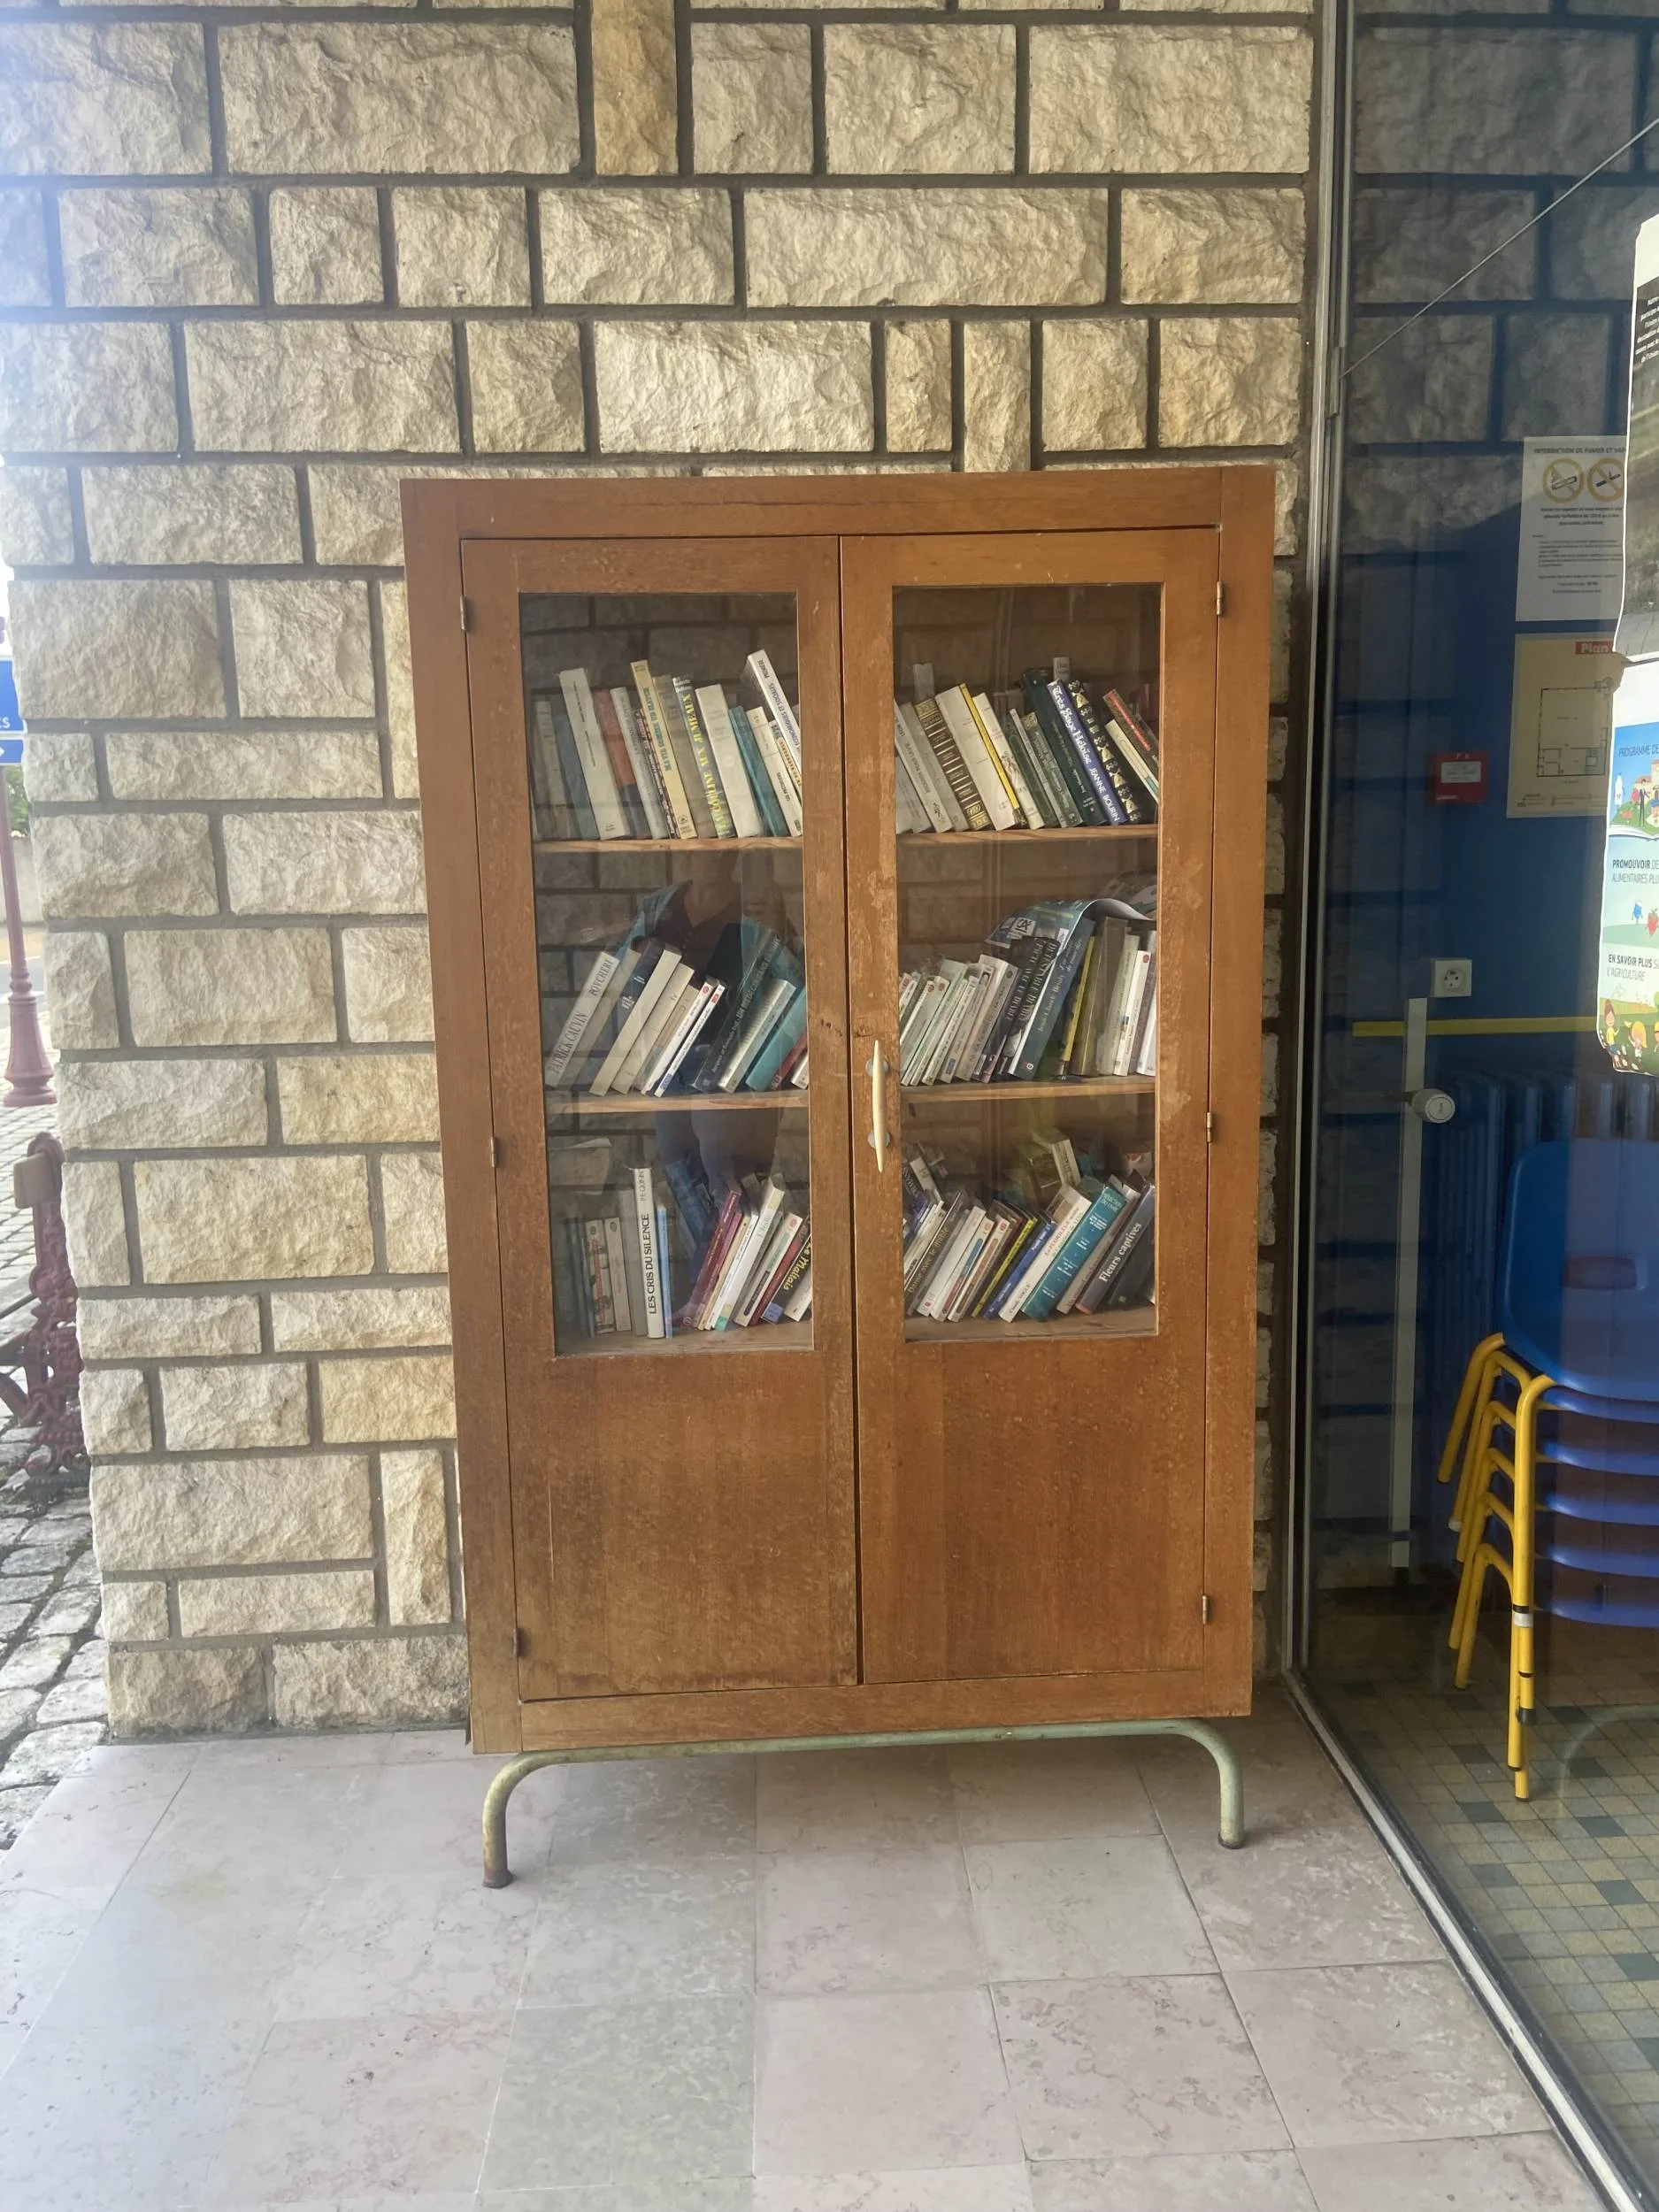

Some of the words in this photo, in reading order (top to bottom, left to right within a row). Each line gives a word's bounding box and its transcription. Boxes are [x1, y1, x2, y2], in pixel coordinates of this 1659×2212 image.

[1581, 642, 1609, 654] Plan
[1049, 684, 1069, 710] Très
[1059, 706, 1079, 733] Sage
[1071, 729, 1094, 764] Héloïse
[1089, 766, 1106, 793] JEANNE
[1102, 793, 1120, 822] BOURIN
[1619, 745, 1651, 757] PROGRAMME
[1612, 859, 1651, 870] PROMOUVOIR
[1612, 872, 1648, 884] ALIMENTAIRES
[1608, 954, 1617, 964] EN
[1617, 955, 1637, 965] SAVOIR
[1638, 957, 1653, 968] PLUS
[1607, 967, 1646, 981] L'AGRICULTURE
[547, 1038, 573, 1074] PATRICK
[563, 1010, 588, 1042] CAUVIN
[640, 1213, 652, 1255] SILENCE
[1098, 1254, 1121, 1283] Fleurs
[1115, 1219, 1143, 1256] captives
[644, 1256, 653, 1270] DU
[782, 1255, 809, 1292] Maltais
[645, 1271, 655, 1294] CRIS
[647, 1295, 657, 1314] LES
